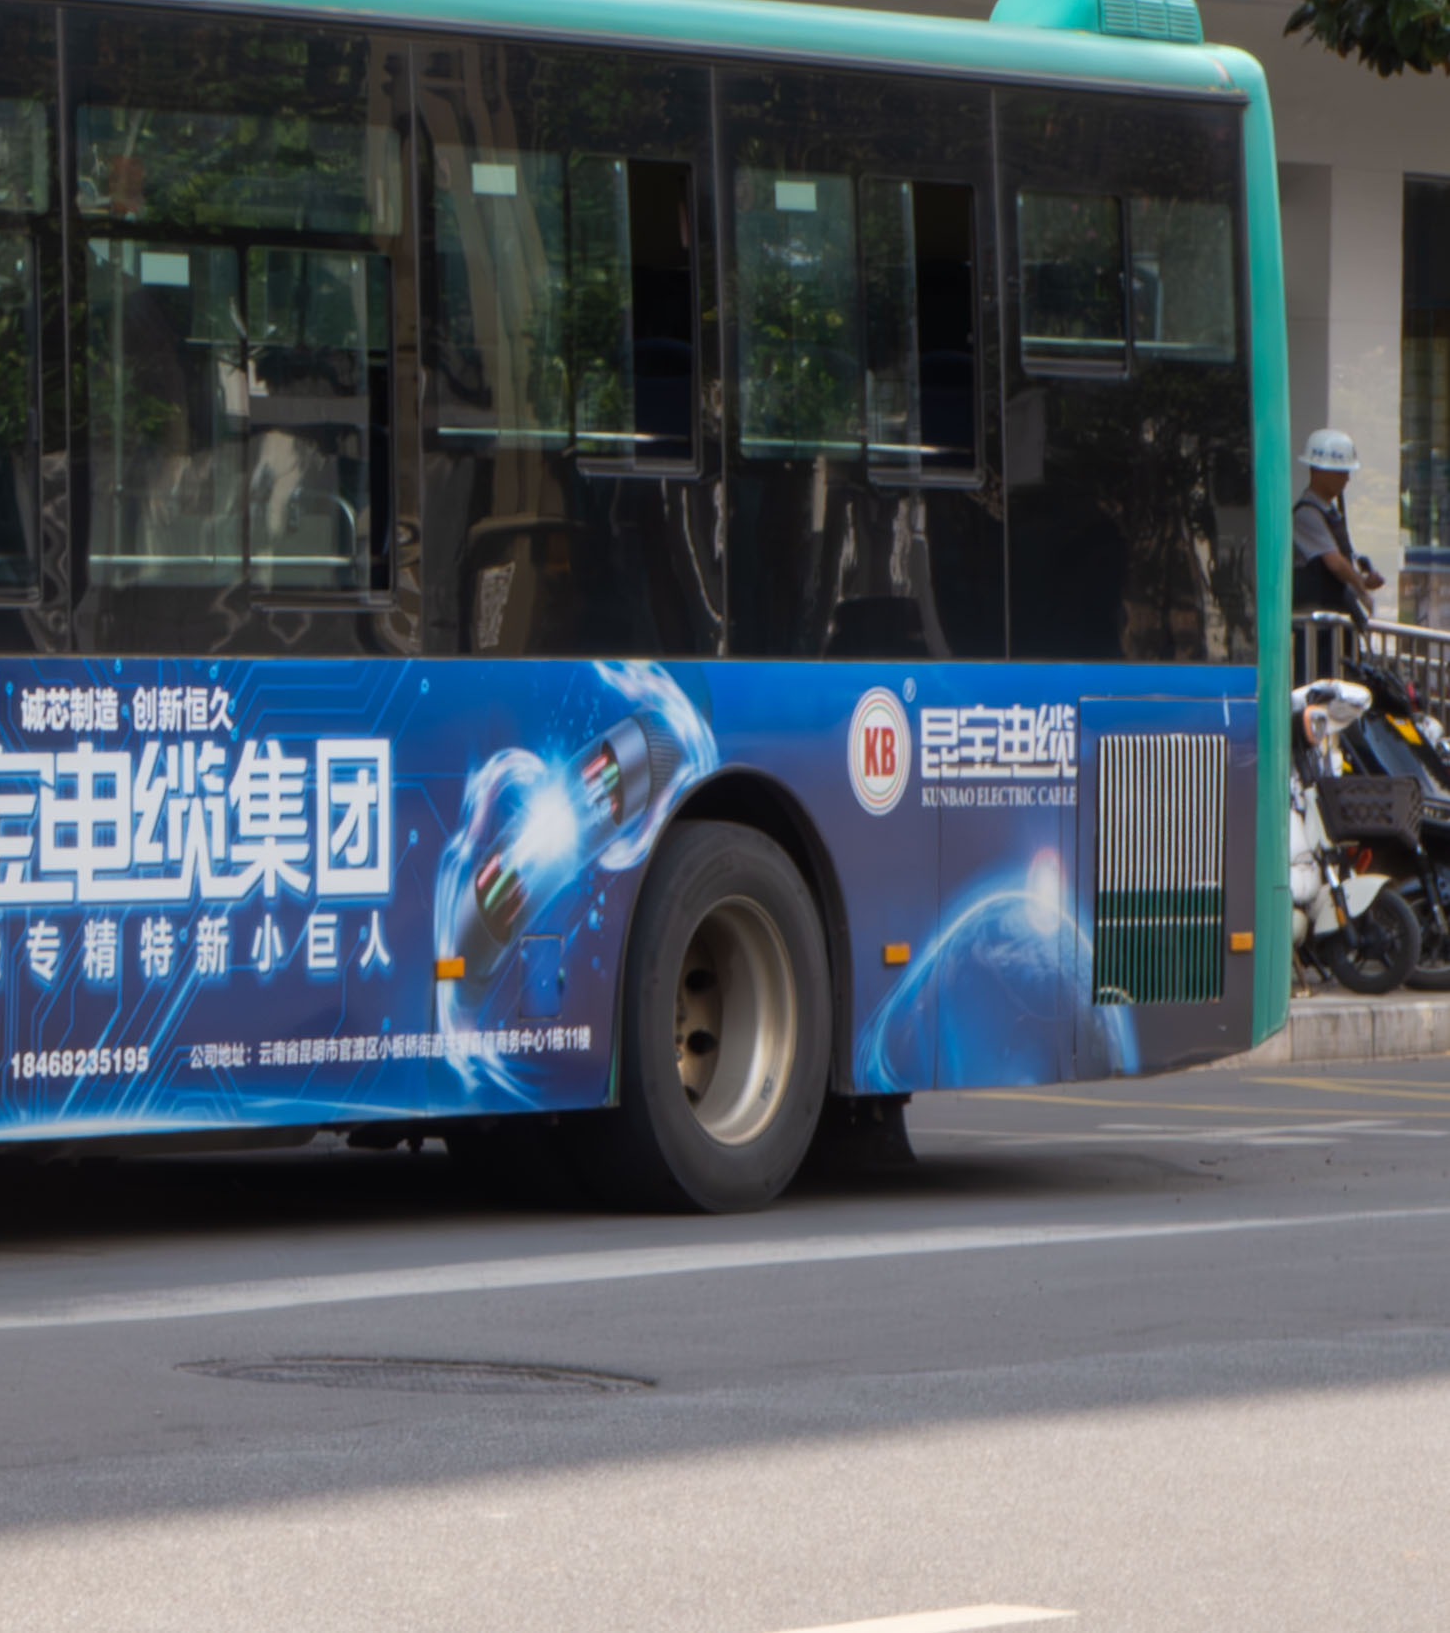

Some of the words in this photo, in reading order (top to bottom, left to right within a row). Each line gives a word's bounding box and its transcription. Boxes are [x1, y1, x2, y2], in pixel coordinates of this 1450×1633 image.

[20, 686, 119, 733] 诚芯制造
[132, 685, 234, 733] 创新恒久
[863, 726, 897, 778] KB
[920, 704, 1078, 780] 昆宝电缆
[921, 785, 975, 807] KUNBAO
[976, 785, 1035, 807] ELECTRIC
[10, 1045, 150, 1080] 18468235195
